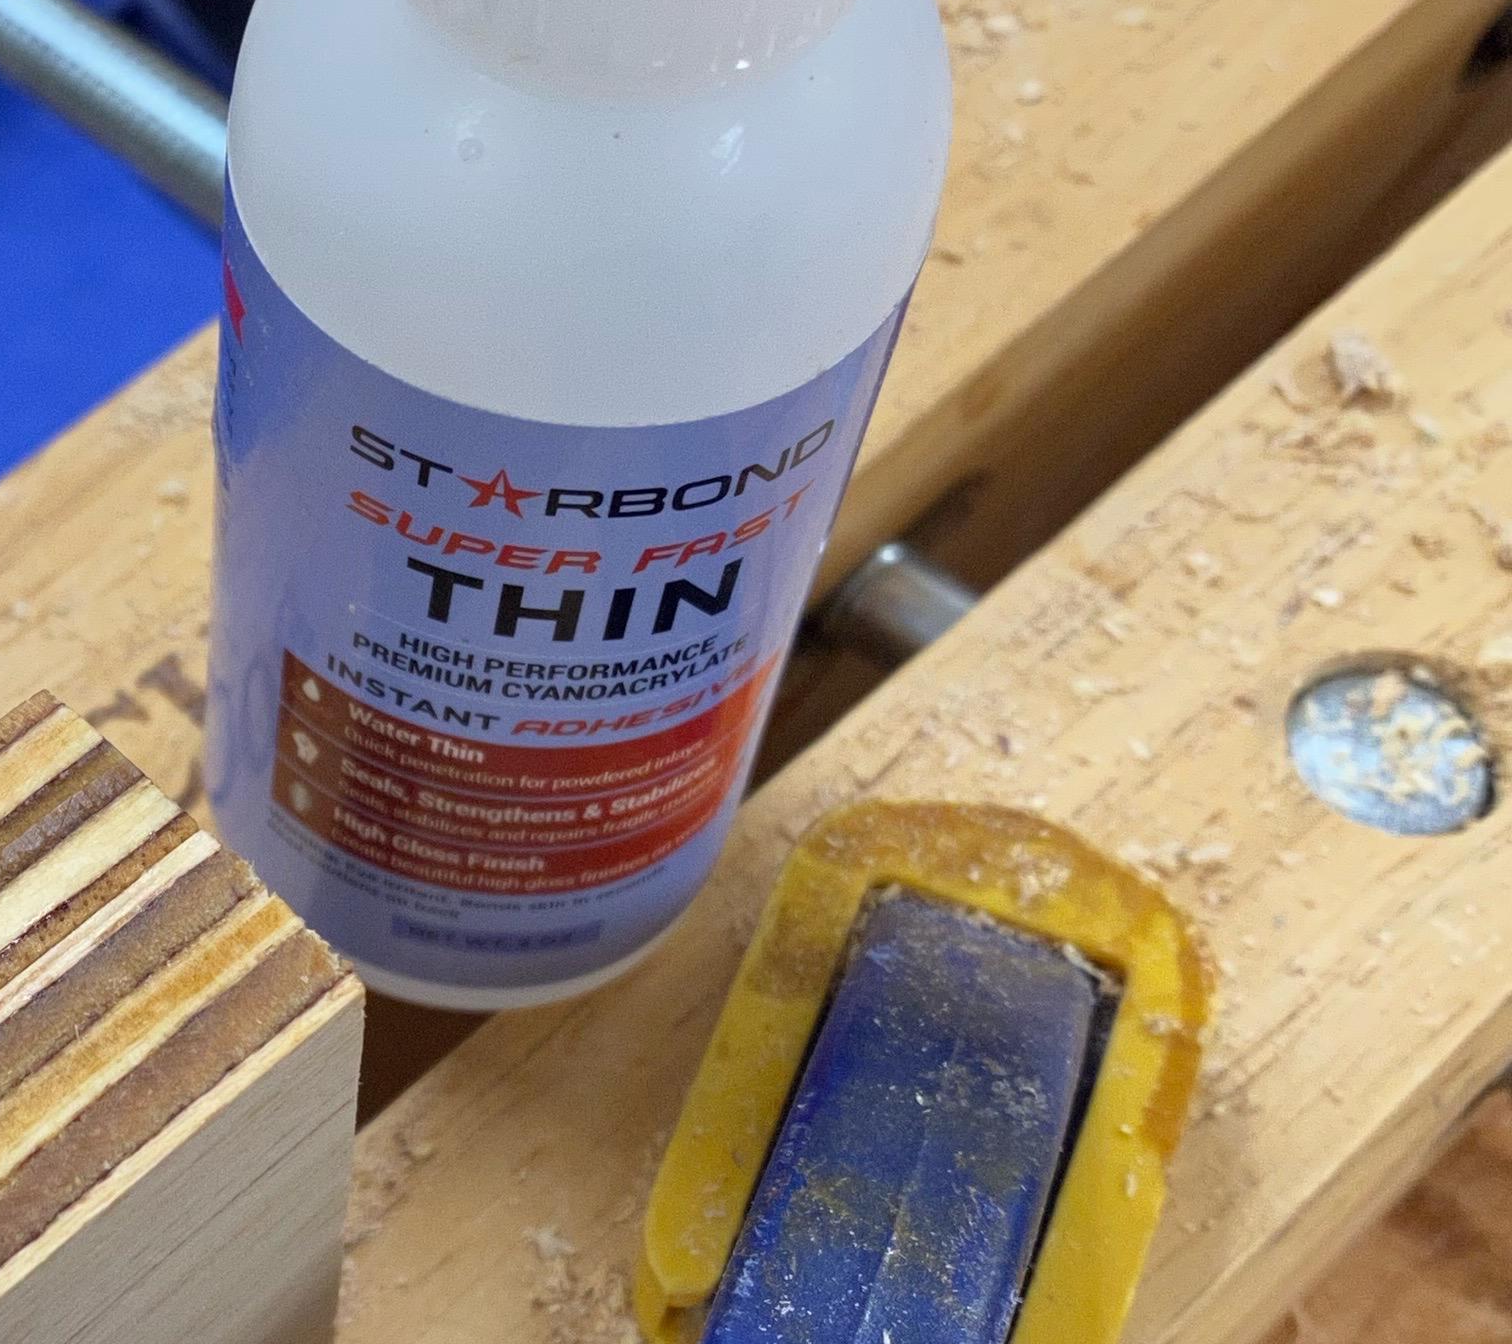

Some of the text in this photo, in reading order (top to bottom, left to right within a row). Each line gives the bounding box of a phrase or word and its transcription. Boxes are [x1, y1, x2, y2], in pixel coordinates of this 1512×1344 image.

[349, 419, 835, 520] STARBOND
[345, 480, 815, 575] SUPER FAST
[407, 557, 744, 641] THIN
[353, 632, 750, 701] PREMIUM CYANOACRYLATE
[399, 633, 719, 682] HIGH PERFORMANCE
[327, 653, 501, 731] INSTANT
[344, 726, 395, 759] Quick
[399, 755, 514, 789] penetration
[519, 774, 547, 790] for
[552, 762, 653, 792] powdered
[348, 702, 485, 763] Water Thin
[341, 758, 409, 803] Seals,
[417, 790, 577, 824] Strengthens
[582, 802, 603, 820] &
[333, 806, 388, 846] High
[391, 833, 461, 865] Gloss
[466, 852, 545, 872] Finish
[487, 828, 525, 842] and
[529, 826, 598, 844] repairs
